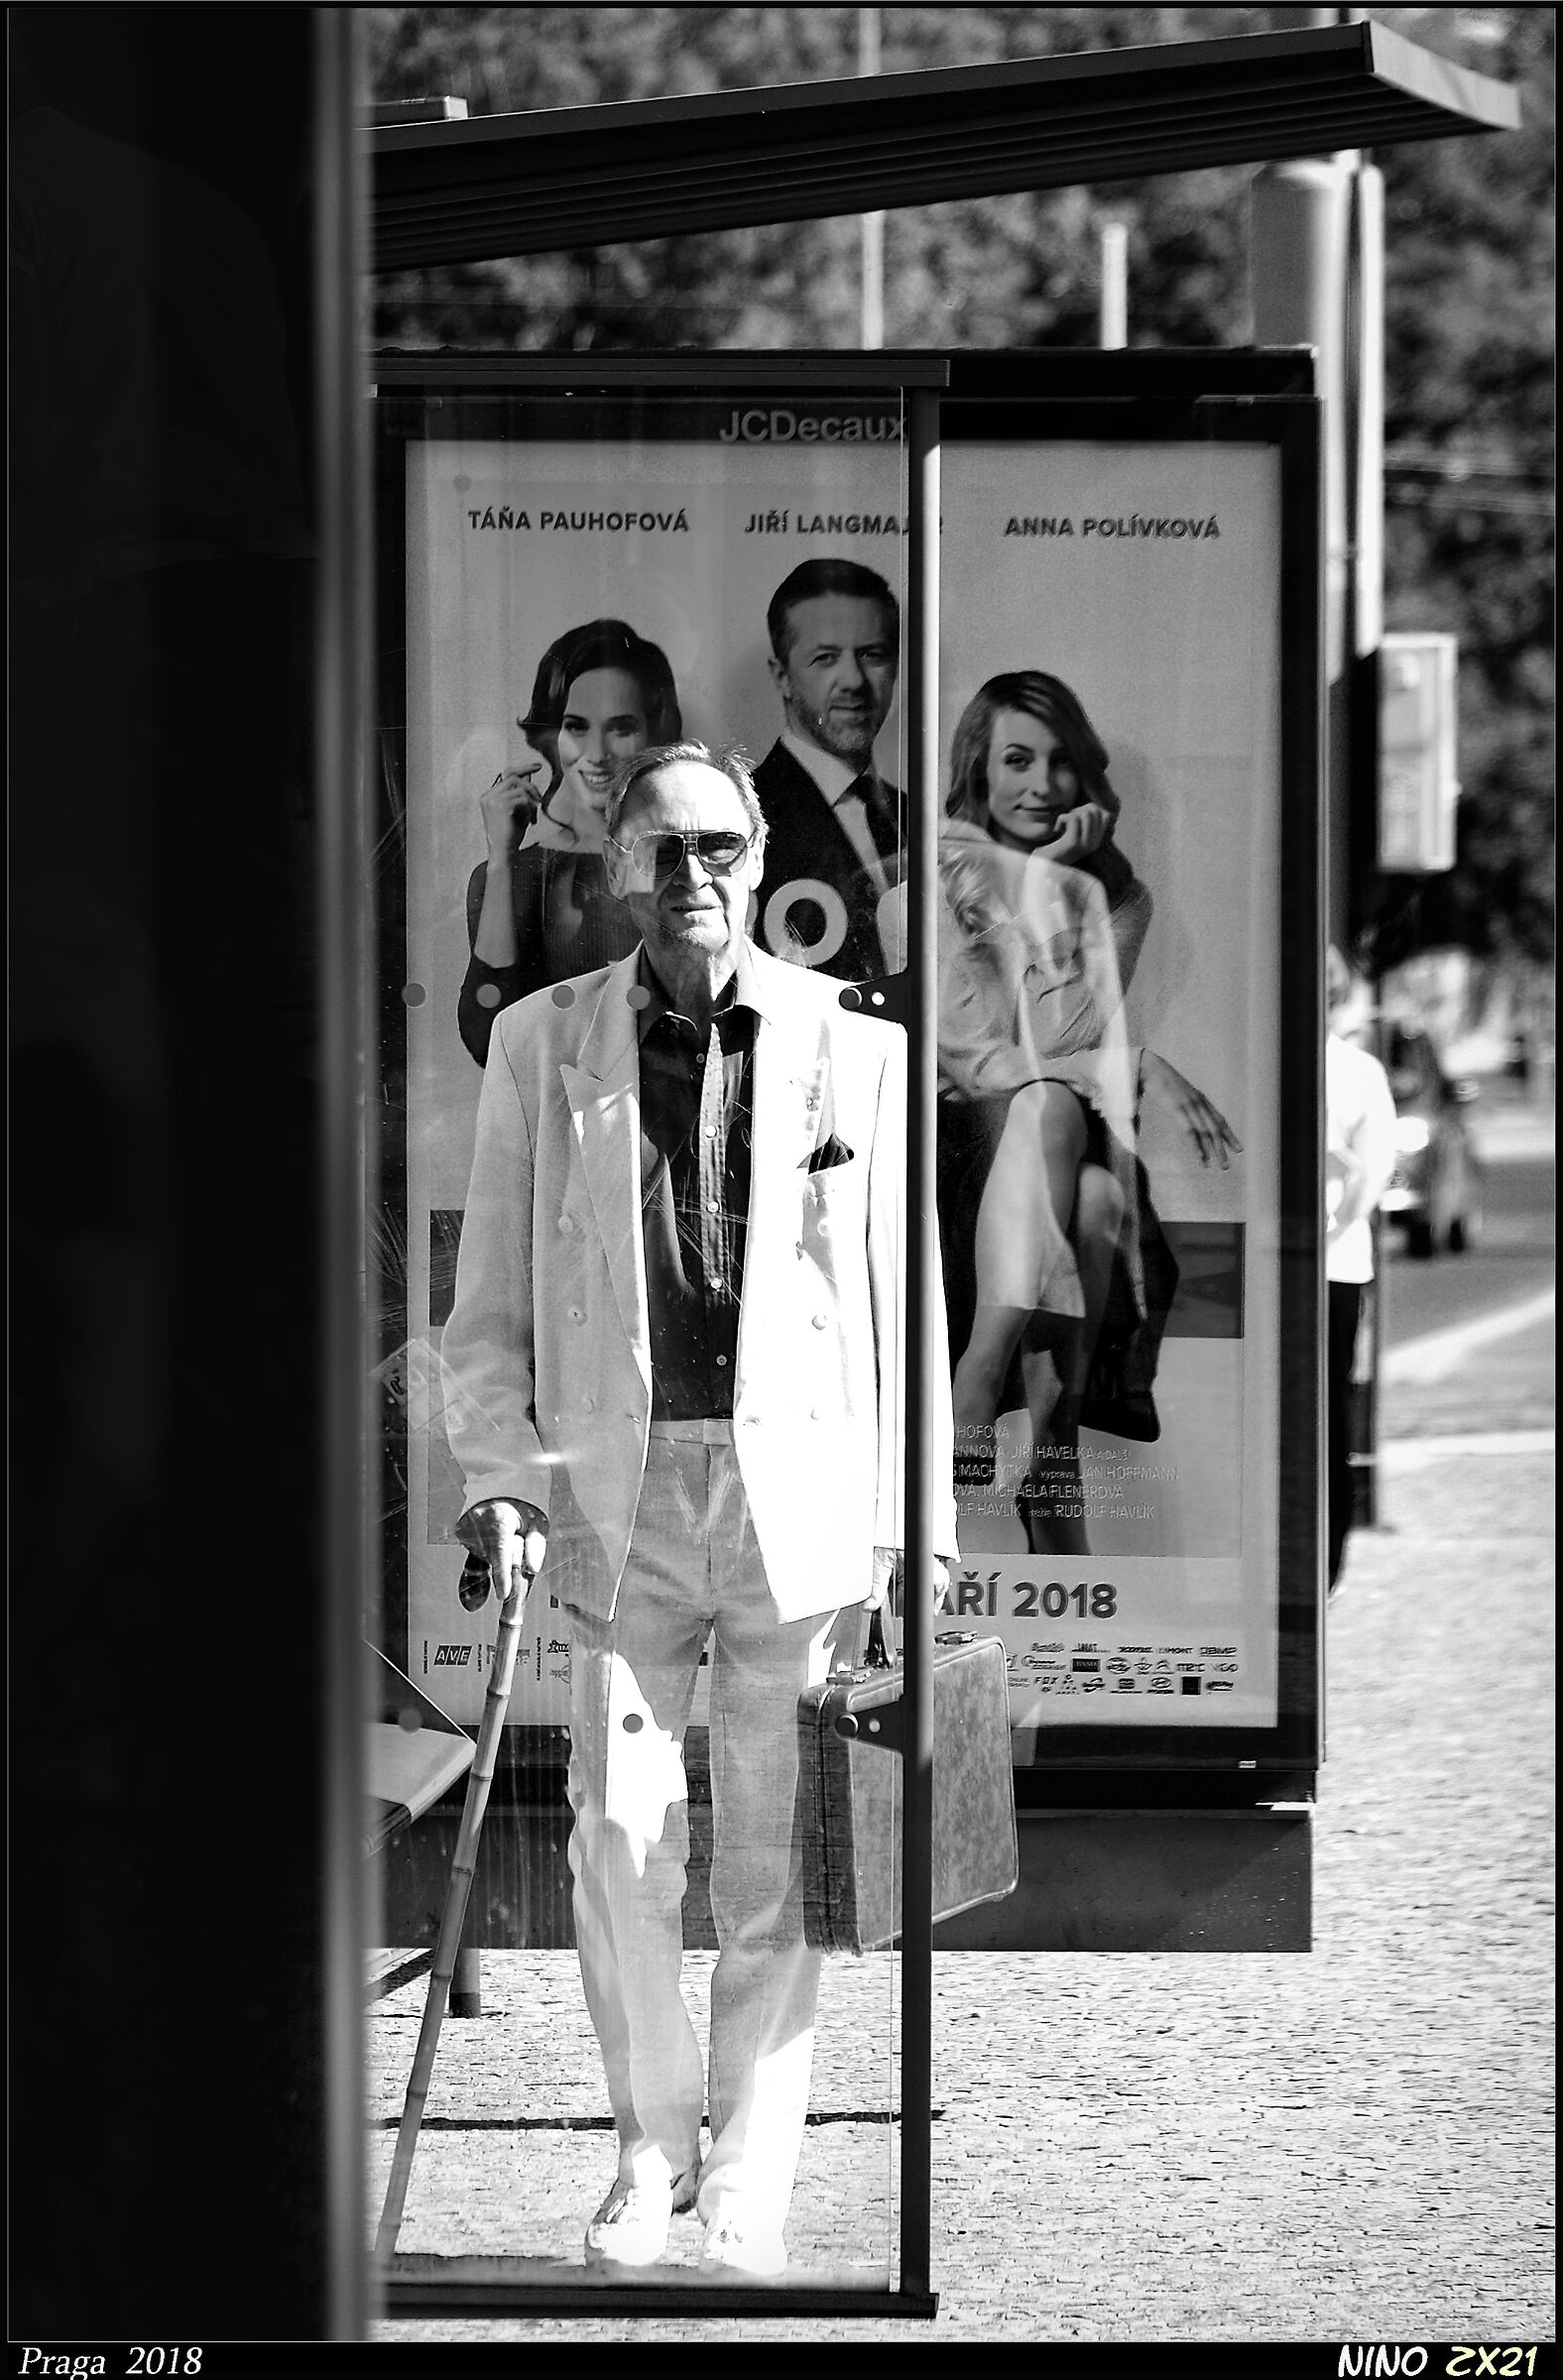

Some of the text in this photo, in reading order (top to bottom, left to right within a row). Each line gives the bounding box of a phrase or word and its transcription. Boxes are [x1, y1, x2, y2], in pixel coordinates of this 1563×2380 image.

[719, 410, 907, 442] JCDecaux
[468, 506, 690, 533] TÁŇA PAUHOFOVÁ
[745, 509, 789, 535] JIŘÍ
[1003, 513, 1221, 540] ANNA POLÍVKOVÁ
[1037, 1445, 1094, 1460] HAVELKA
[1078, 1467, 1103, 1480] JAN
[983, 1484, 1047, 1498] MICHAELA
[977, 1498, 1022, 1517] HAVLÍK
[1054, 1503, 1106, 1518] RUDOLF
[1012, 1582, 1118, 1619] 2018
[435, 1649, 471, 1663] AVE
